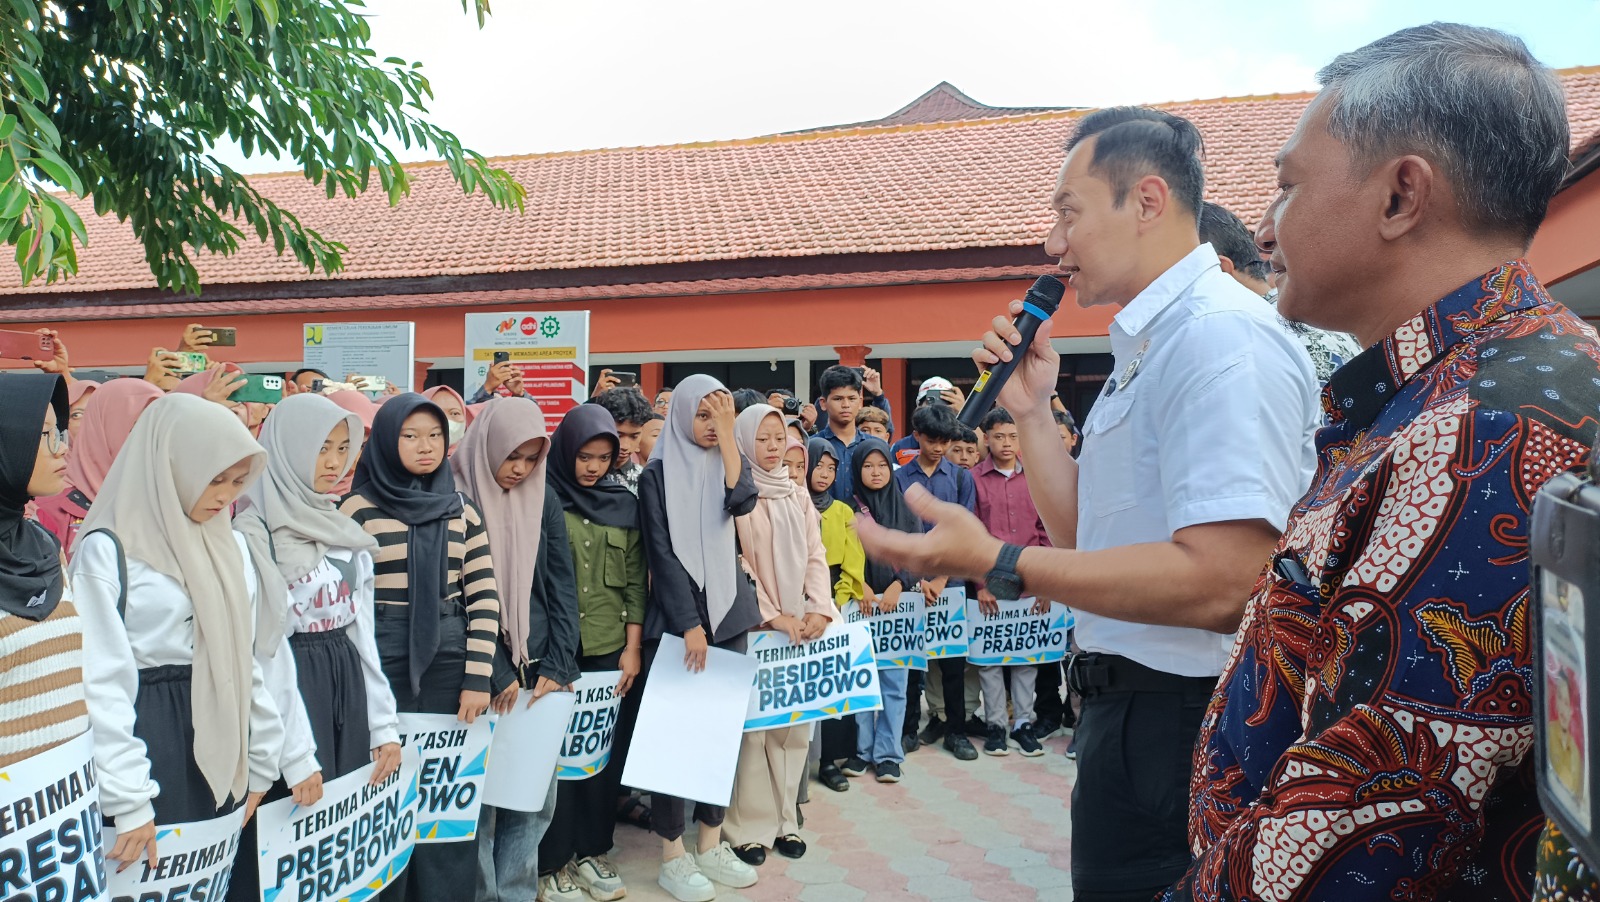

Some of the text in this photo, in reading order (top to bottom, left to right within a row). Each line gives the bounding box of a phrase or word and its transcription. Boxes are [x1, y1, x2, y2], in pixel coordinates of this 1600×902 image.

[521, 322, 537, 331] adhi
[869, 617, 915, 638] SIDEN
[973, 618, 1051, 641] PRESIDEN
[982, 631, 1063, 655] PRABOWO
[755, 633, 850, 664] TERIMA KASIH
[752, 651, 852, 691] RESIDEN
[759, 668, 873, 712] PRABOWO
[419, 750, 462, 785] EN
[0, 770, 84, 838] ERIMA
[292, 790, 358, 842] TERIMA
[275, 788, 401, 890] PRESIDEN
[297, 808, 415, 902] PRABOWO
